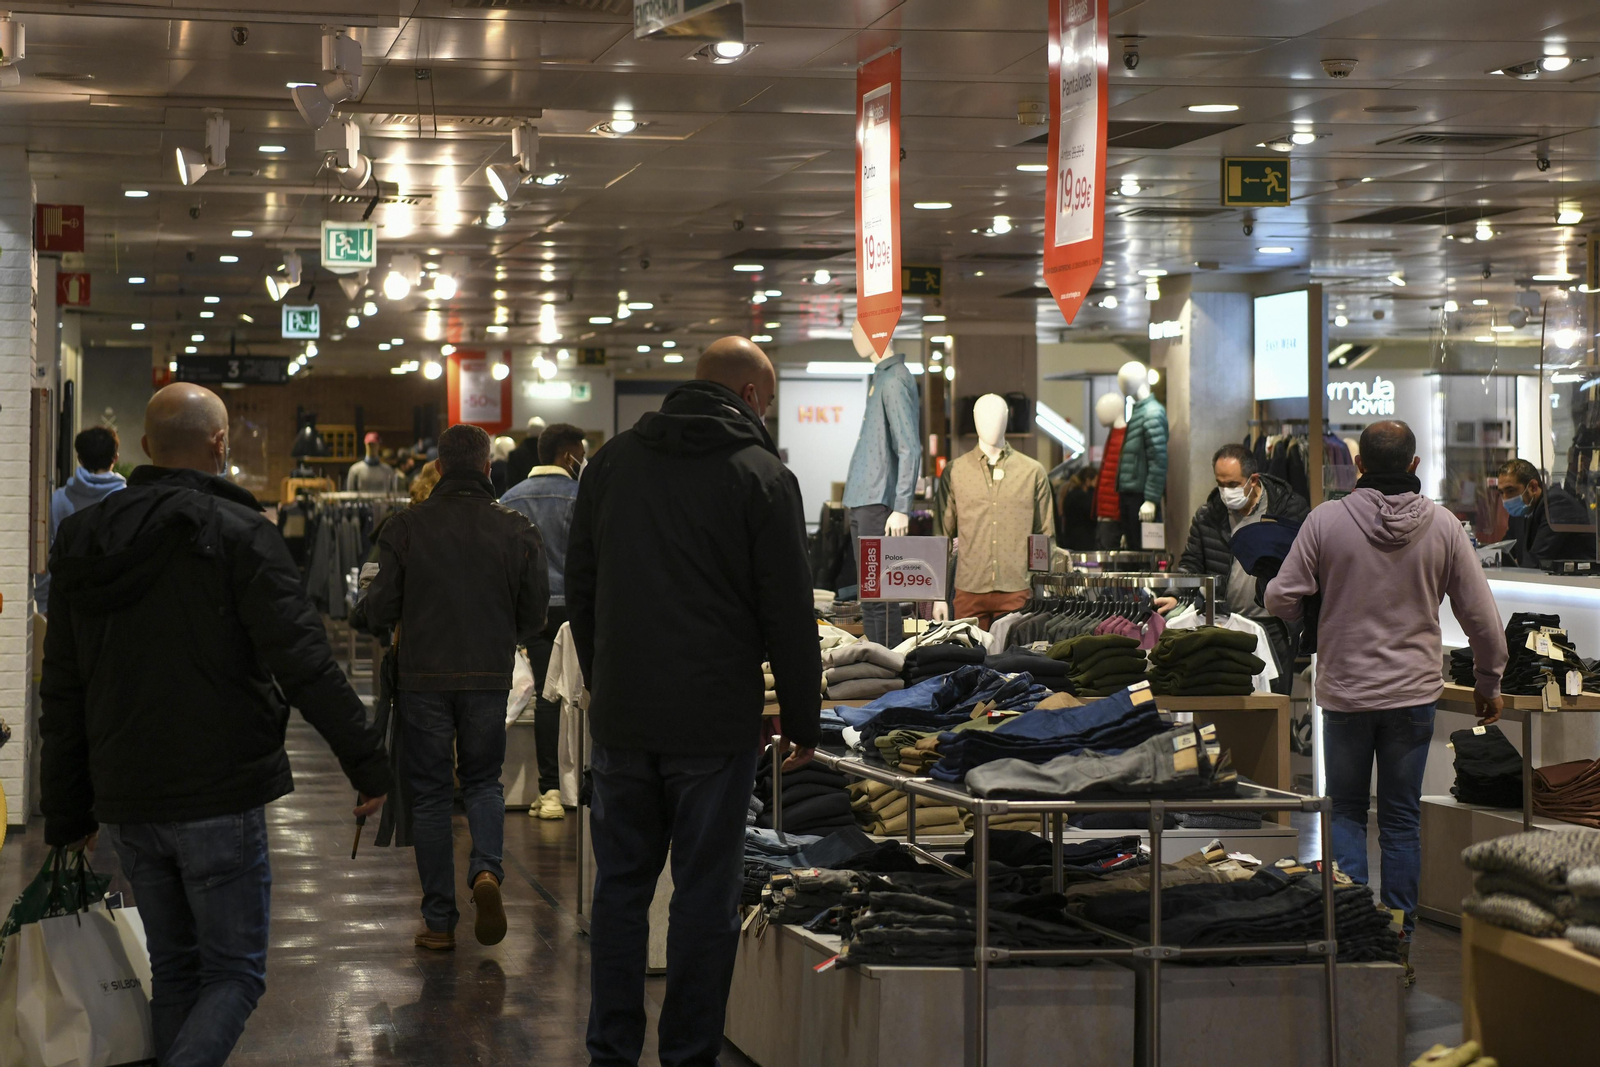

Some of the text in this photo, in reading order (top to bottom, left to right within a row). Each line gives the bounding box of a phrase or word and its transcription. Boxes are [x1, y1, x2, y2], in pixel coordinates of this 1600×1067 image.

[1062, 72, 1092, 98] Pantalones
[1059, 167, 1092, 217] 19,99€
[865, 234, 891, 273] 19,99€
[228, 360, 240, 379] 3
[1327, 376, 1395, 400] rmula
[1348, 400, 1395, 415] JOVEN
[866, 547, 878, 592] rebajas
[886, 571, 933, 588] 19,99€
[111, 978, 142, 991] SILBON
